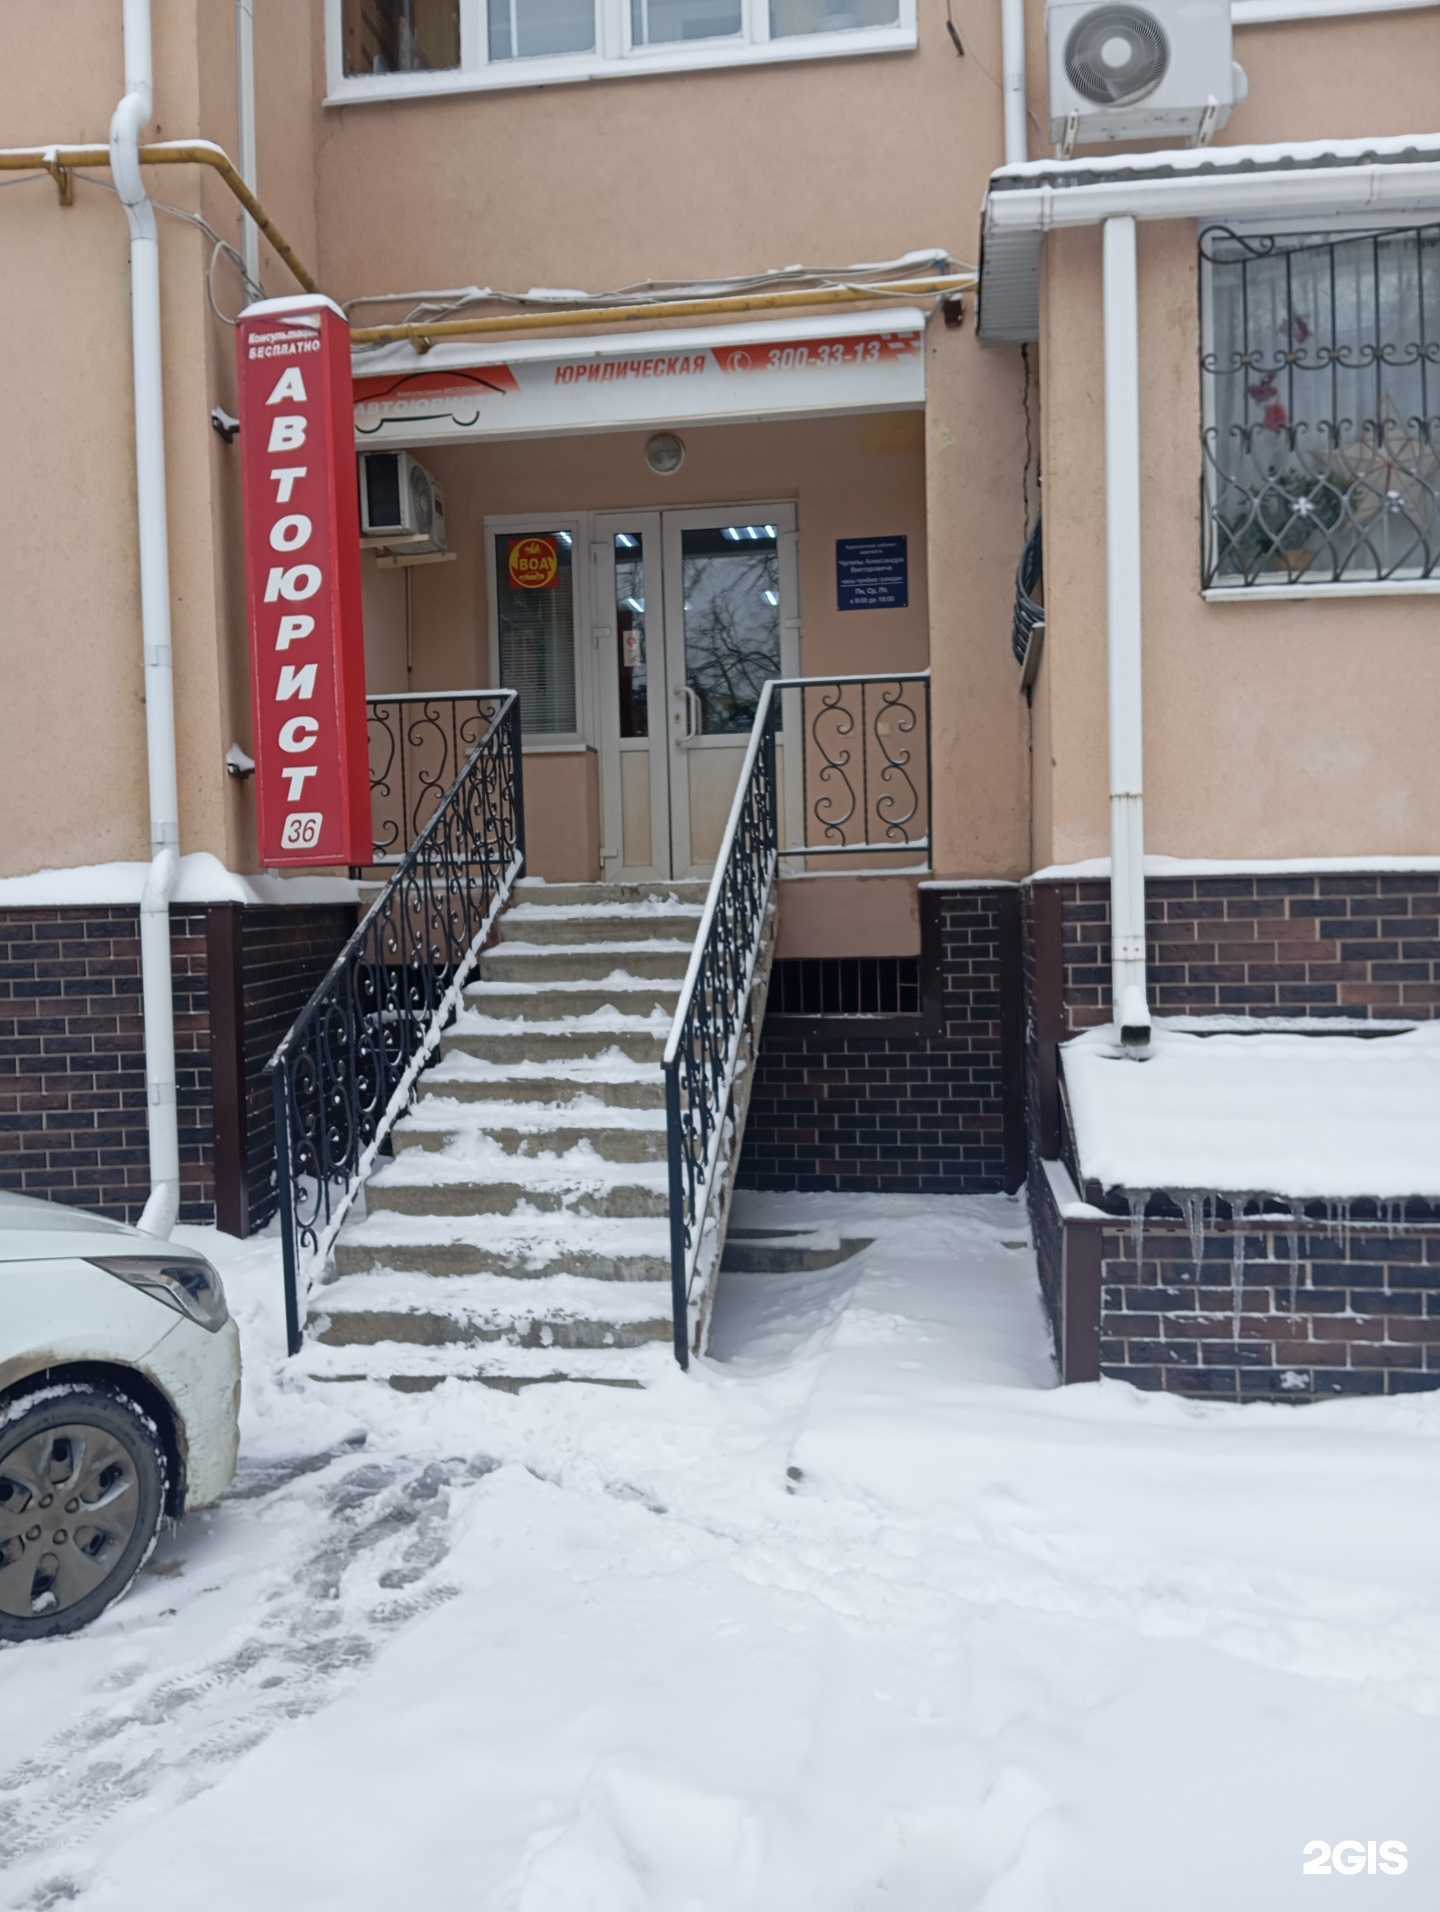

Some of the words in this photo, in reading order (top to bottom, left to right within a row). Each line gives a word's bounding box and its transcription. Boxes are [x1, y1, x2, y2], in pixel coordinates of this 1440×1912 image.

[248, 340, 320, 359] БЕСПЛАТНО
[766, 341, 881, 370] 300-33-13
[554, 355, 706, 385] ЮРИДИЧЕСКАЯ
[263, 367, 322, 802] АВТОЮРИСТ
[287, 819, 317, 843] 36
